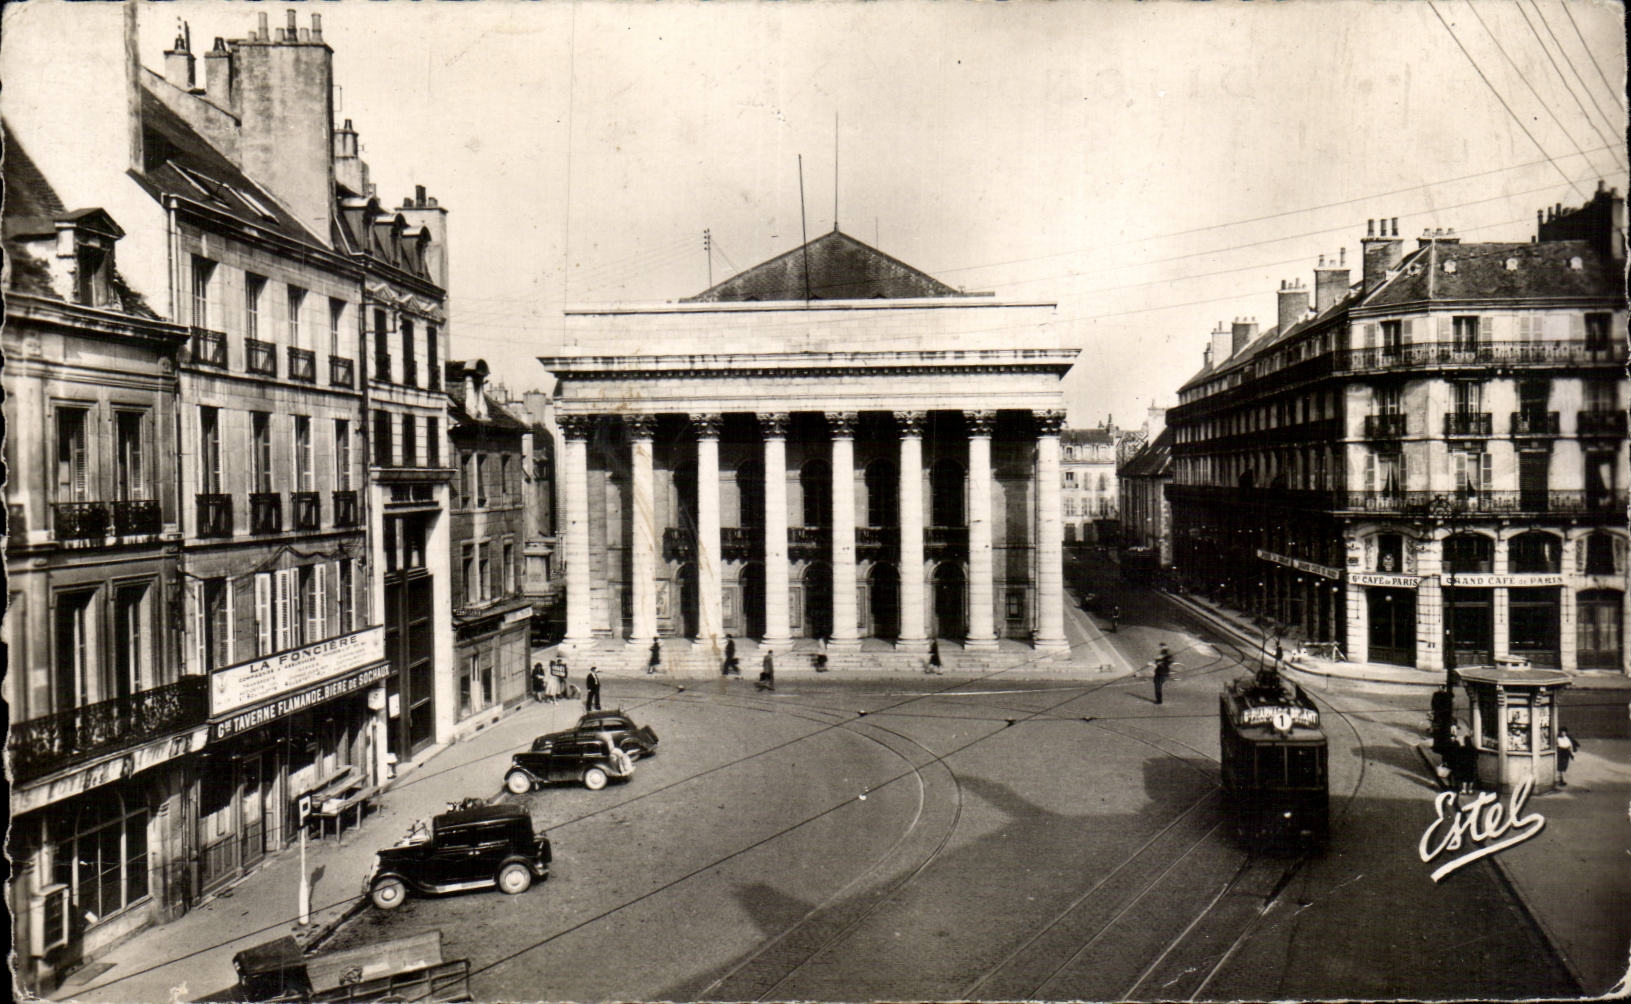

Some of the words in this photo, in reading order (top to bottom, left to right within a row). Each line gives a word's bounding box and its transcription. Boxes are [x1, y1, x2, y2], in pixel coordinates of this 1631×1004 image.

[1392, 577, 1419, 587] PARIS
[1446, 577, 1484, 585] GRAND
[1530, 576, 1563, 585] PARIS
[250, 660, 270, 674] LA
[279, 634, 358, 665] FONCIÈRE
[233, 704, 276, 732] TAVERNE
[348, 678, 357, 690] DE
[358, 664, 390, 686] SOCHAUX
[1279, 714, 1285, 728] 1
